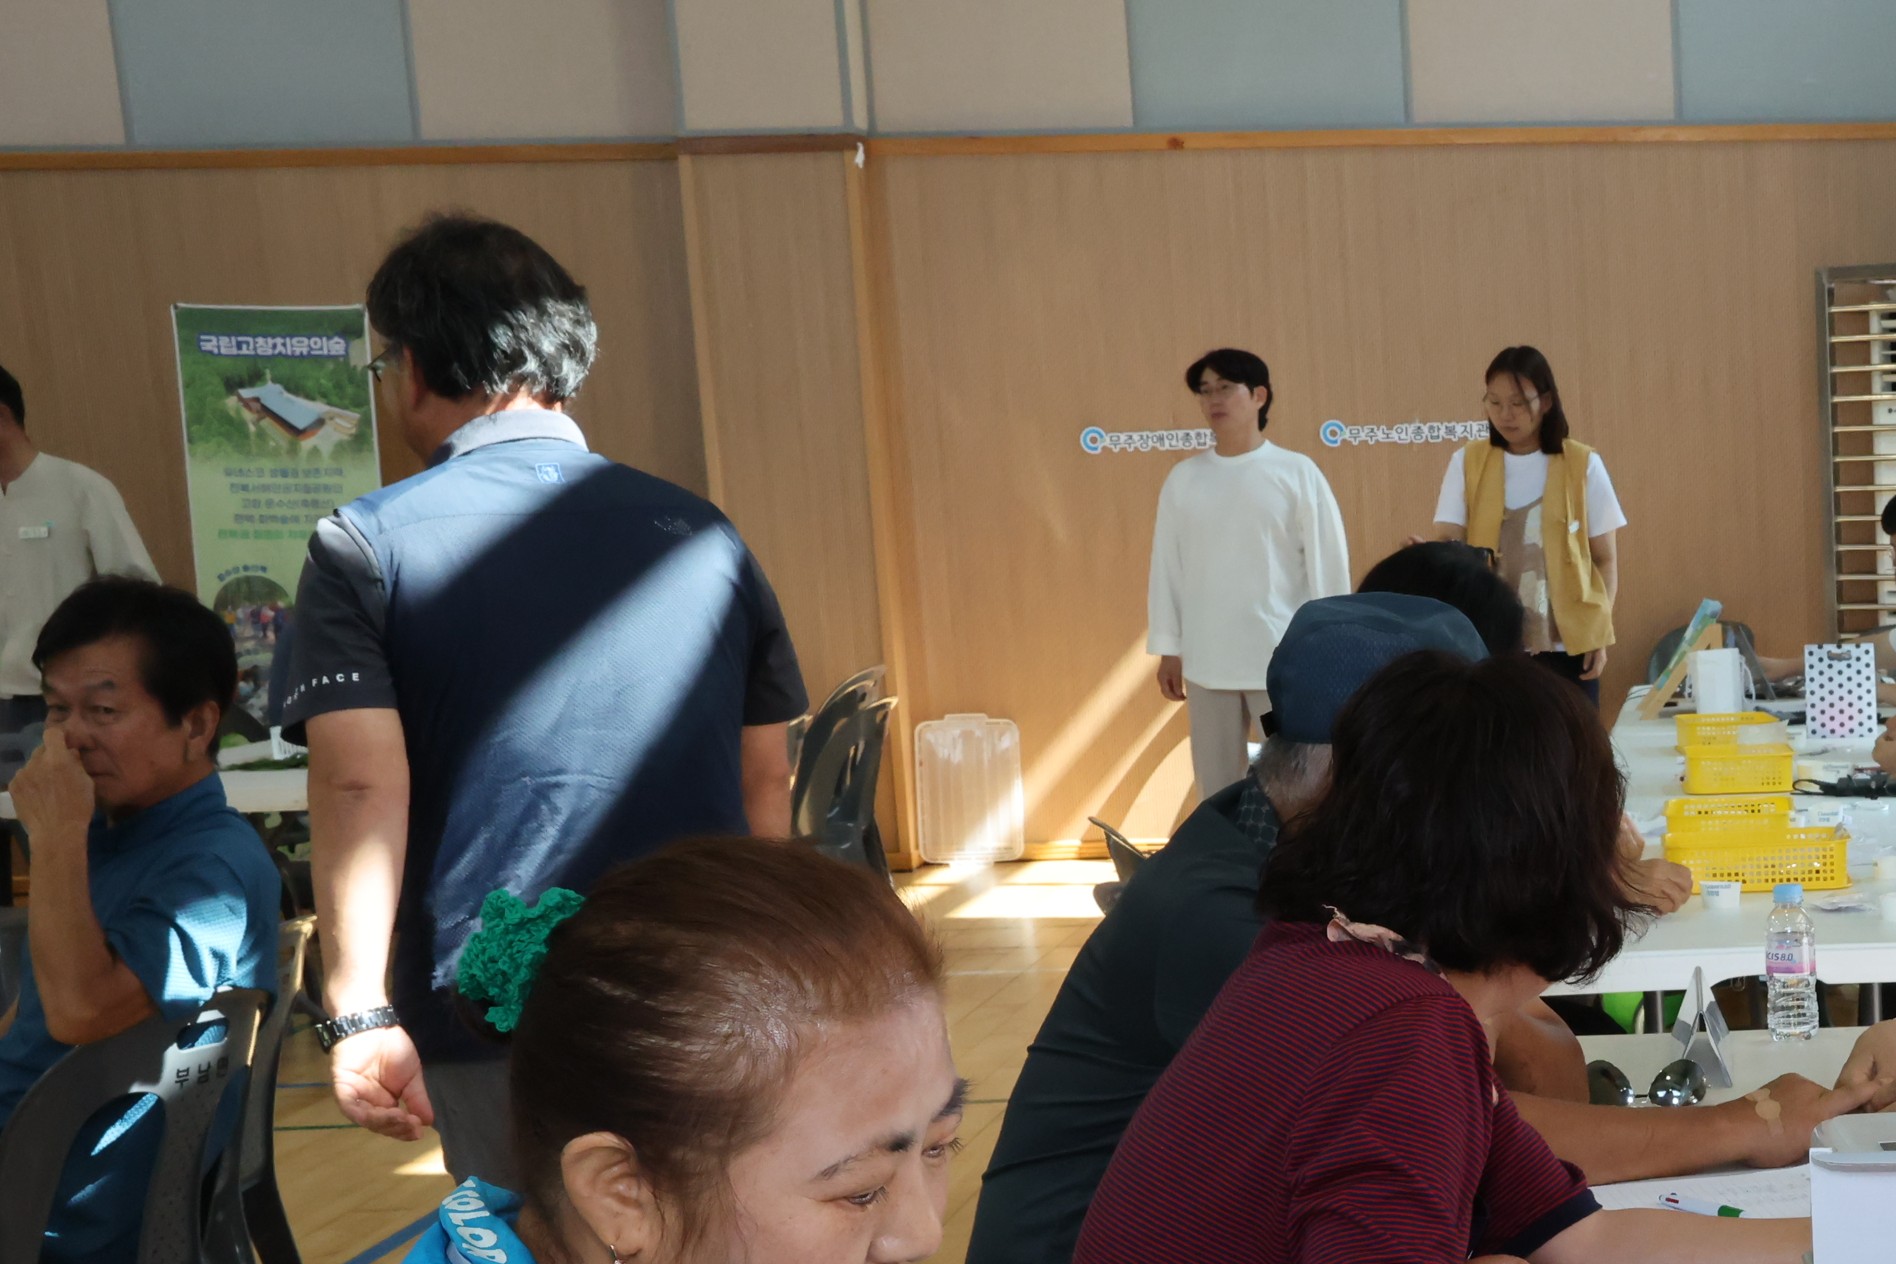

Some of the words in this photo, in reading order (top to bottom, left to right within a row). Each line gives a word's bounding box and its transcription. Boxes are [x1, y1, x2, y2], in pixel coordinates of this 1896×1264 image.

[199, 335, 346, 356] 국립고창치유의숲
[1109, 431, 1216, 449] 무주장애인종합
[1350, 423, 1489, 441] 무주노인종합복지관
[312, 672, 360, 687] FACE
